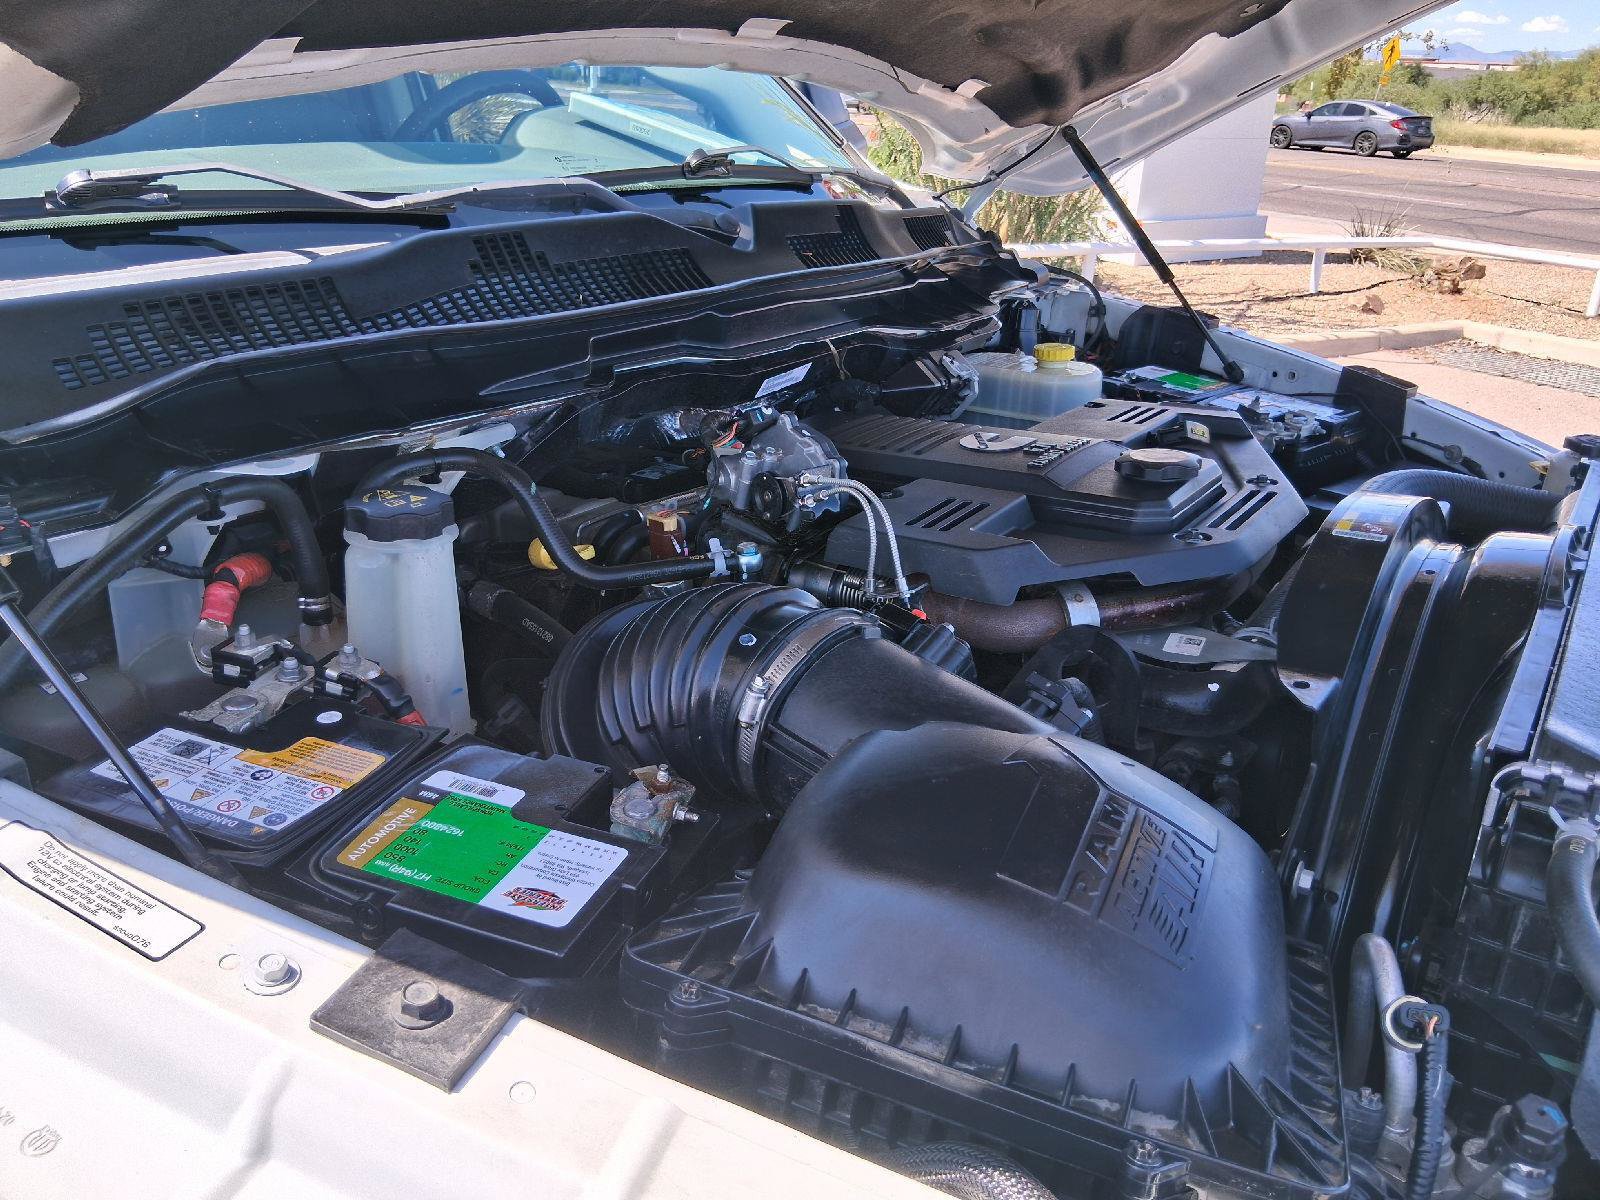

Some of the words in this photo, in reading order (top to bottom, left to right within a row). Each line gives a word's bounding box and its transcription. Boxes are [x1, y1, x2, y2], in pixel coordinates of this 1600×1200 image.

[347, 806, 416, 861] AUTOMOTIVE
[393, 843, 419, 856] 1000
[403, 836, 422, 845] 140
[412, 828, 429, 837] 80
[1064, 798, 1129, 909] RAM
[34, 859, 69, 880] charging
[77, 883, 97, 895] jump
[44, 841, 56, 851] Do
[68, 859, 88, 872] apply
[87, 870, 108, 883] more
[107, 881, 125, 893] than
[125, 891, 157, 909] nominal
[384, 851, 406, 863] 850
[1111, 815, 1168, 931] ACTIVE
[27, 860, 53, 877] Engine
[51, 877, 68, 887] and
[66, 886, 95, 904] starting
[95, 903, 123, 920] system
[38, 847, 54, 860] 12V
[62, 865, 97, 884] electrical
[95, 884, 121, 900] system
[121, 899, 146, 916] during
[55, 889, 77, 902] could
[453, 883, 481, 894] GROUP
[1146, 830, 1206, 955] AIR
